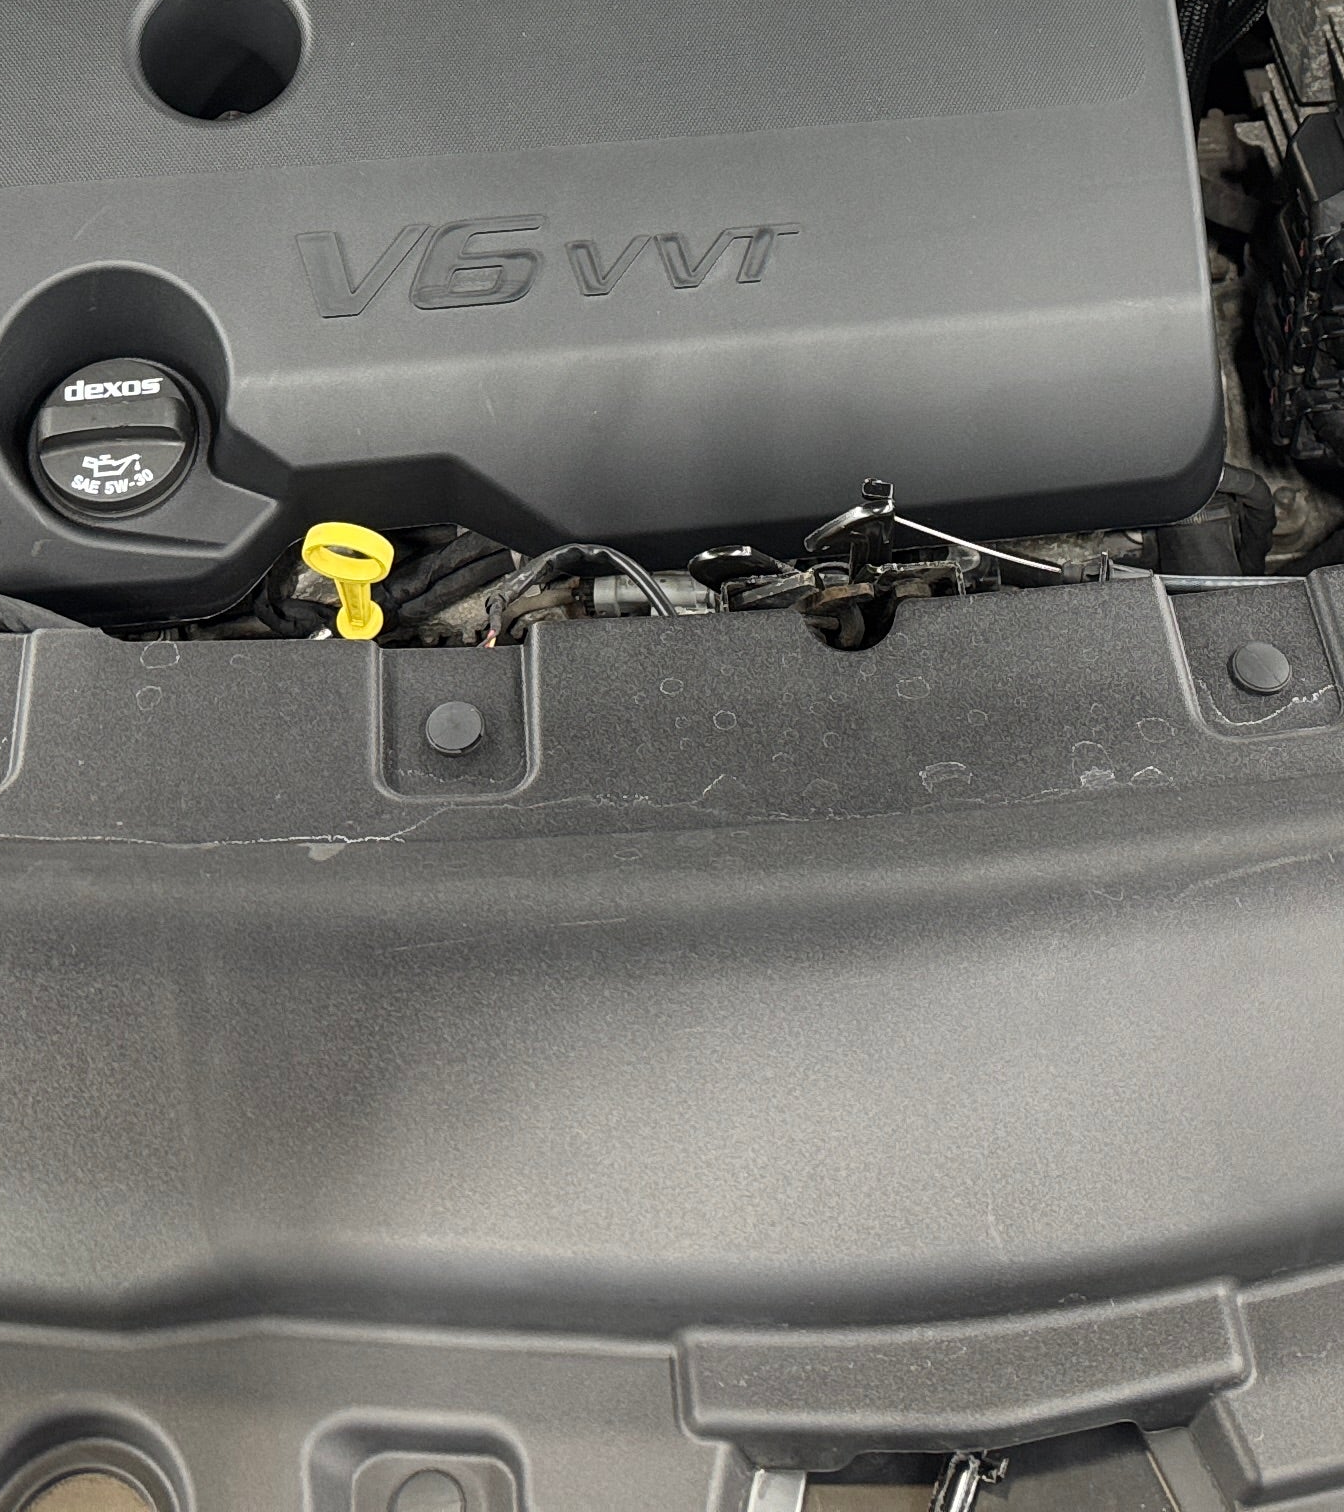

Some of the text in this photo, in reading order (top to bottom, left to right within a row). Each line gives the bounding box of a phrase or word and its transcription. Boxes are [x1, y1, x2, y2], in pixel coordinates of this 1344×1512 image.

[293, 213, 802, 320] V6 VVT
[63, 376, 164, 402] dexos
[70, 468, 154, 496] SAE 5W-30
